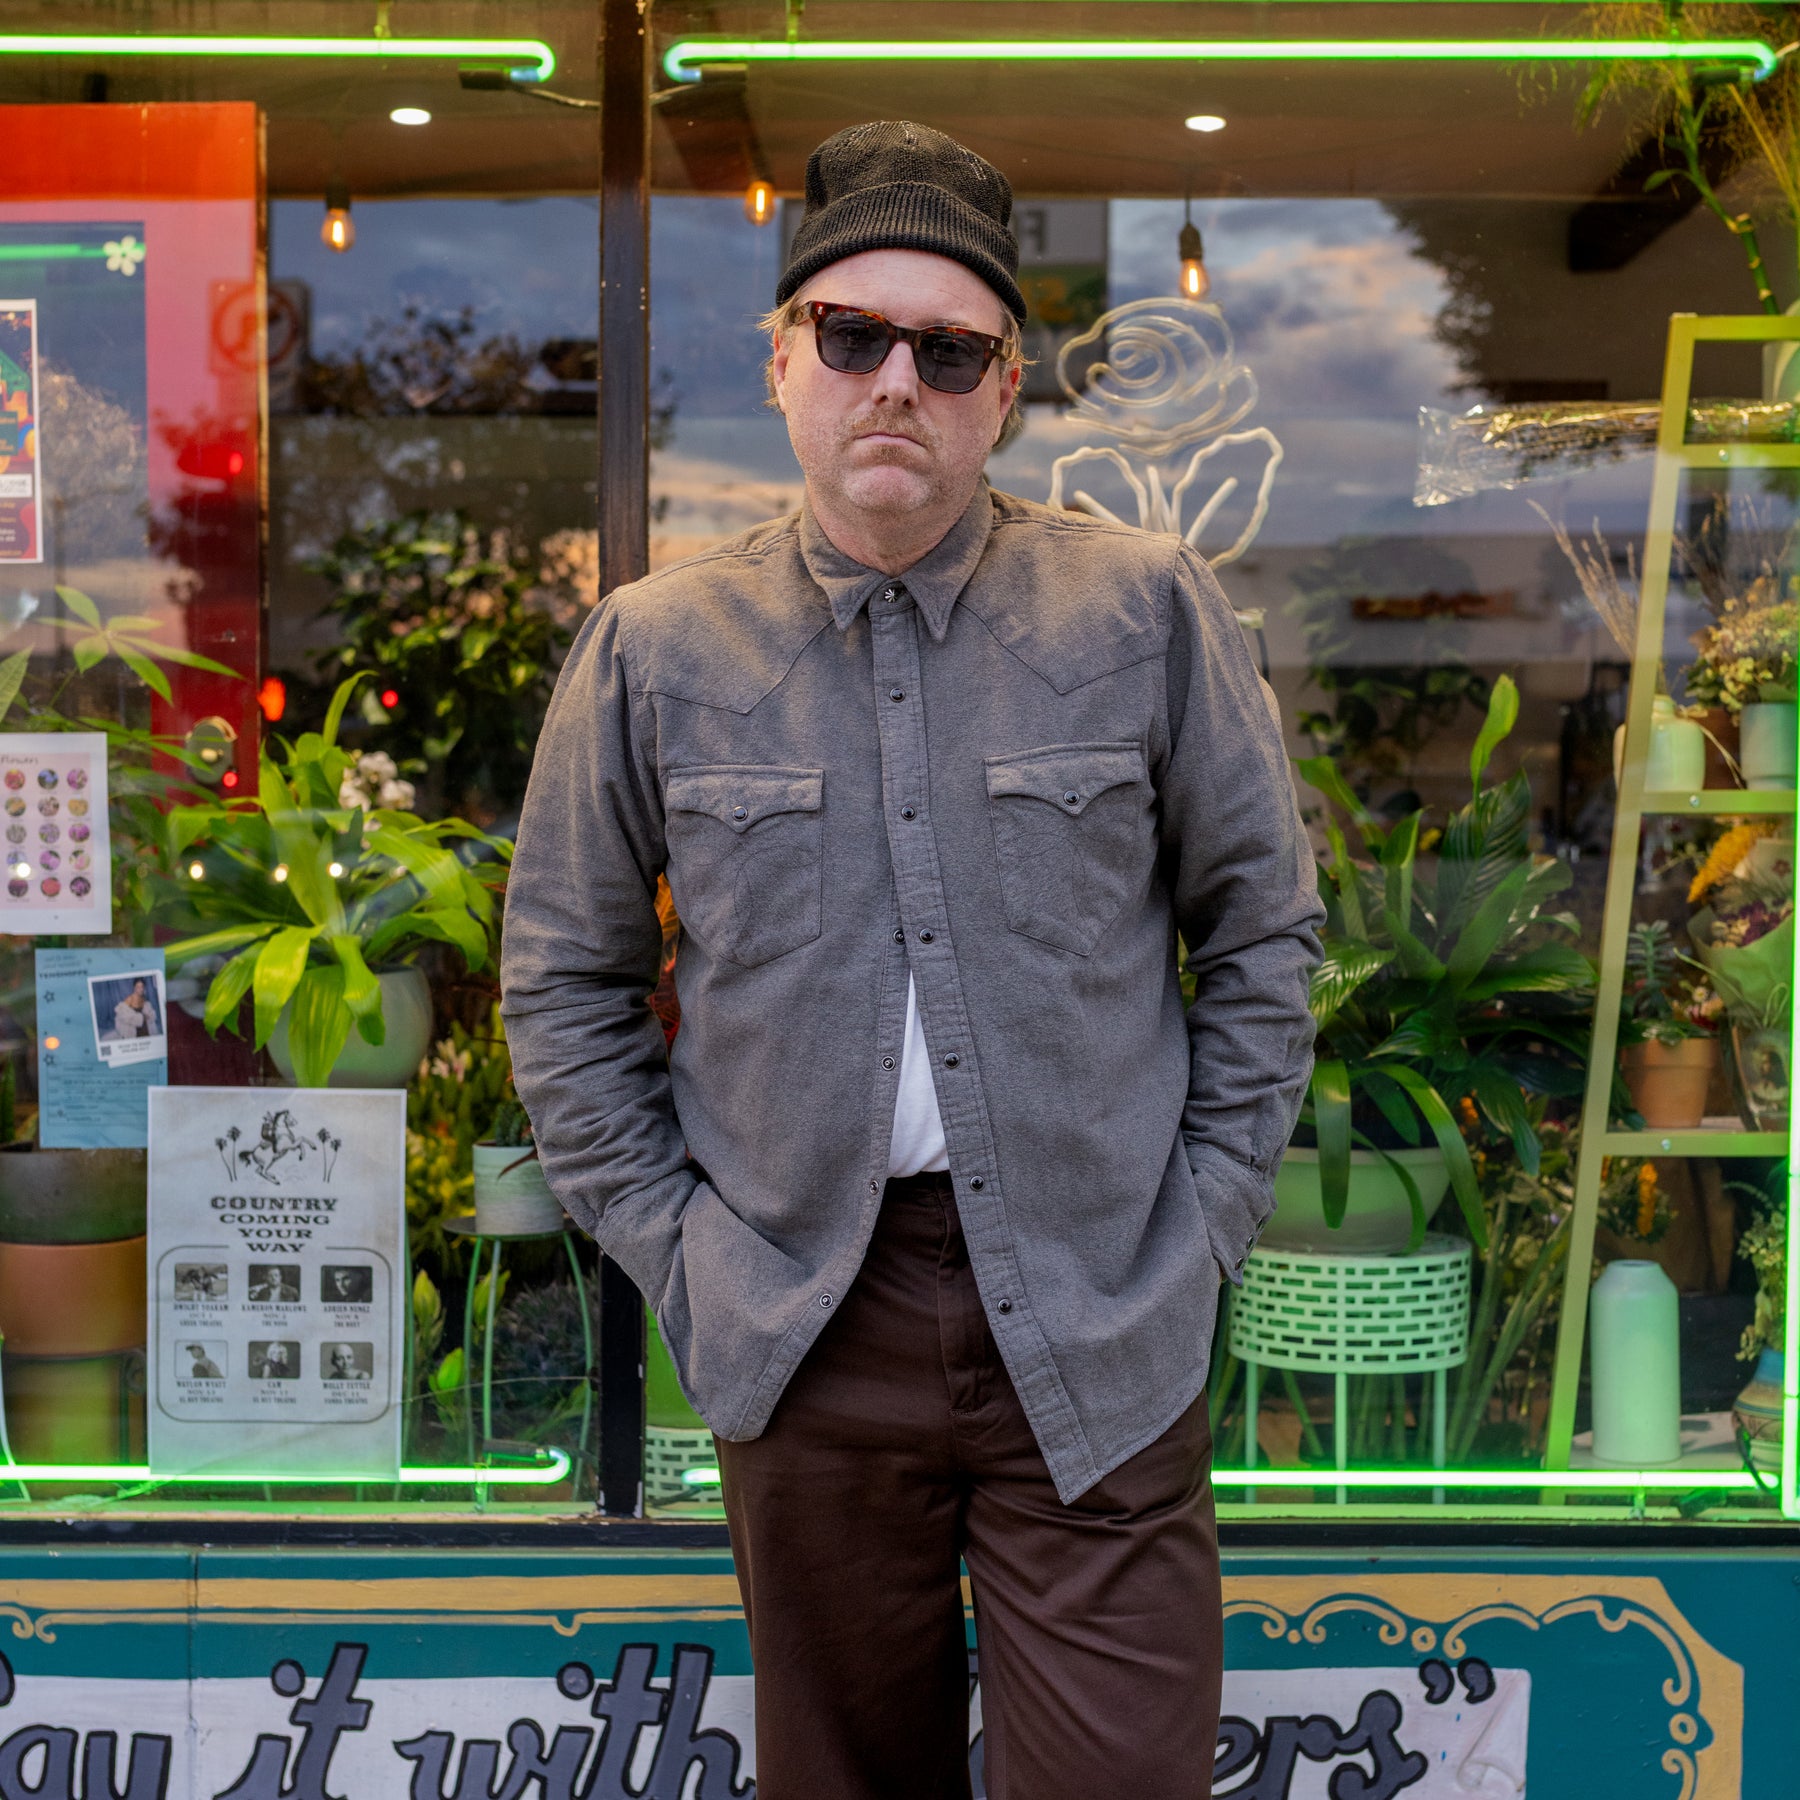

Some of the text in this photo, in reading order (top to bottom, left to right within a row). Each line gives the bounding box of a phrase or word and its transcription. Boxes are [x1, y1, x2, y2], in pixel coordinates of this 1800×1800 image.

[210, 1196, 338, 1211] COUNTRY
[219, 1213, 330, 1226] COMING
[238, 1228, 313, 1239] YOUR
[246, 1242, 305, 1254] WAY
[0, 1651, 172, 1800] ay
[213, 1641, 374, 1800] it
[391, 1642, 757, 1800] with
